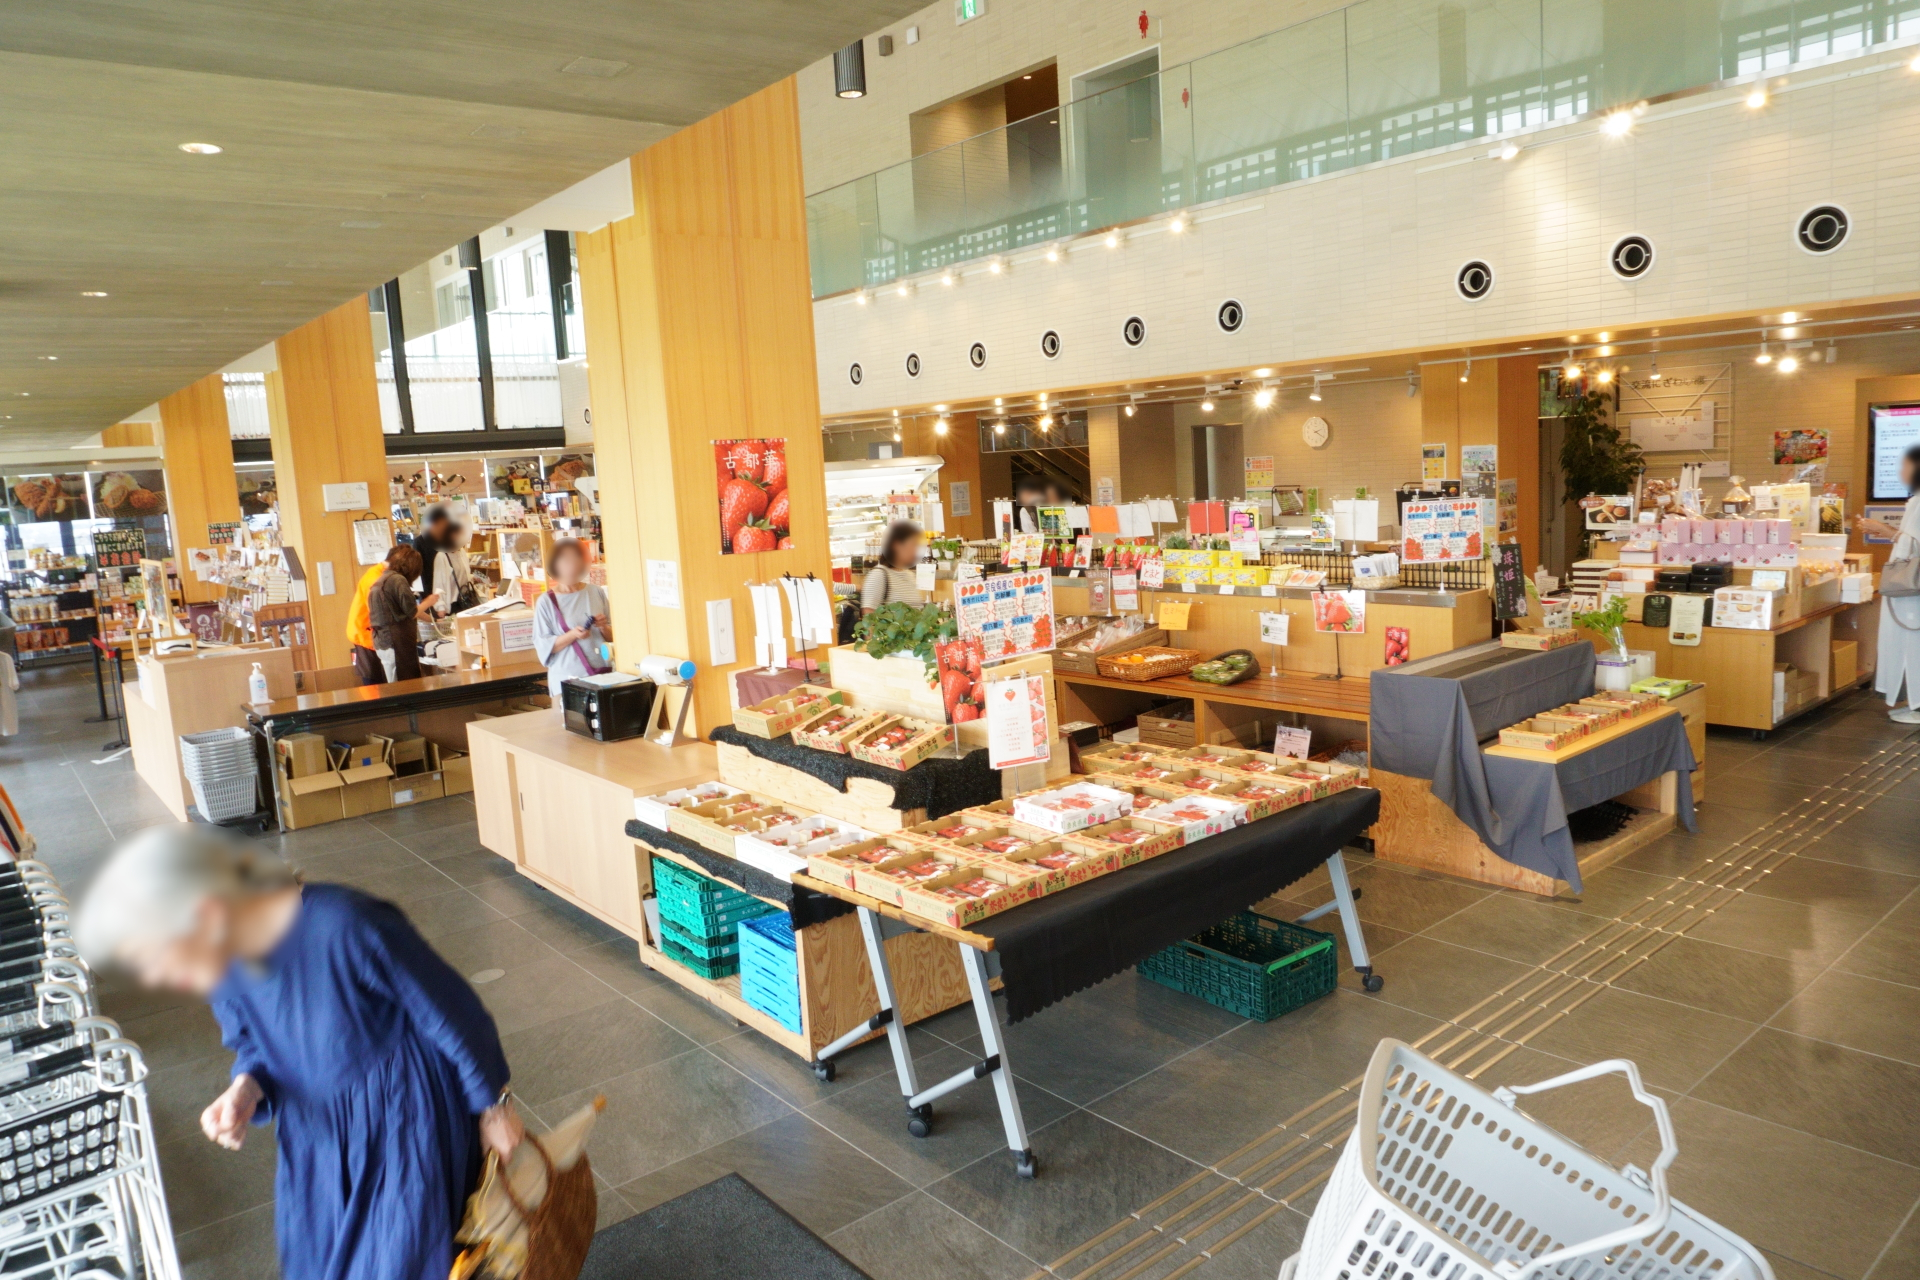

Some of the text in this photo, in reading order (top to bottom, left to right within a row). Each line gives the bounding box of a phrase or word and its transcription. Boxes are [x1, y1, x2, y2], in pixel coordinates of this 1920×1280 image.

[723, 449, 778, 470] 古都華
[1143, 569, 1160, 579] とまと
[941, 646, 978, 665] 古都華
[775, 714, 803, 731] 古都華
